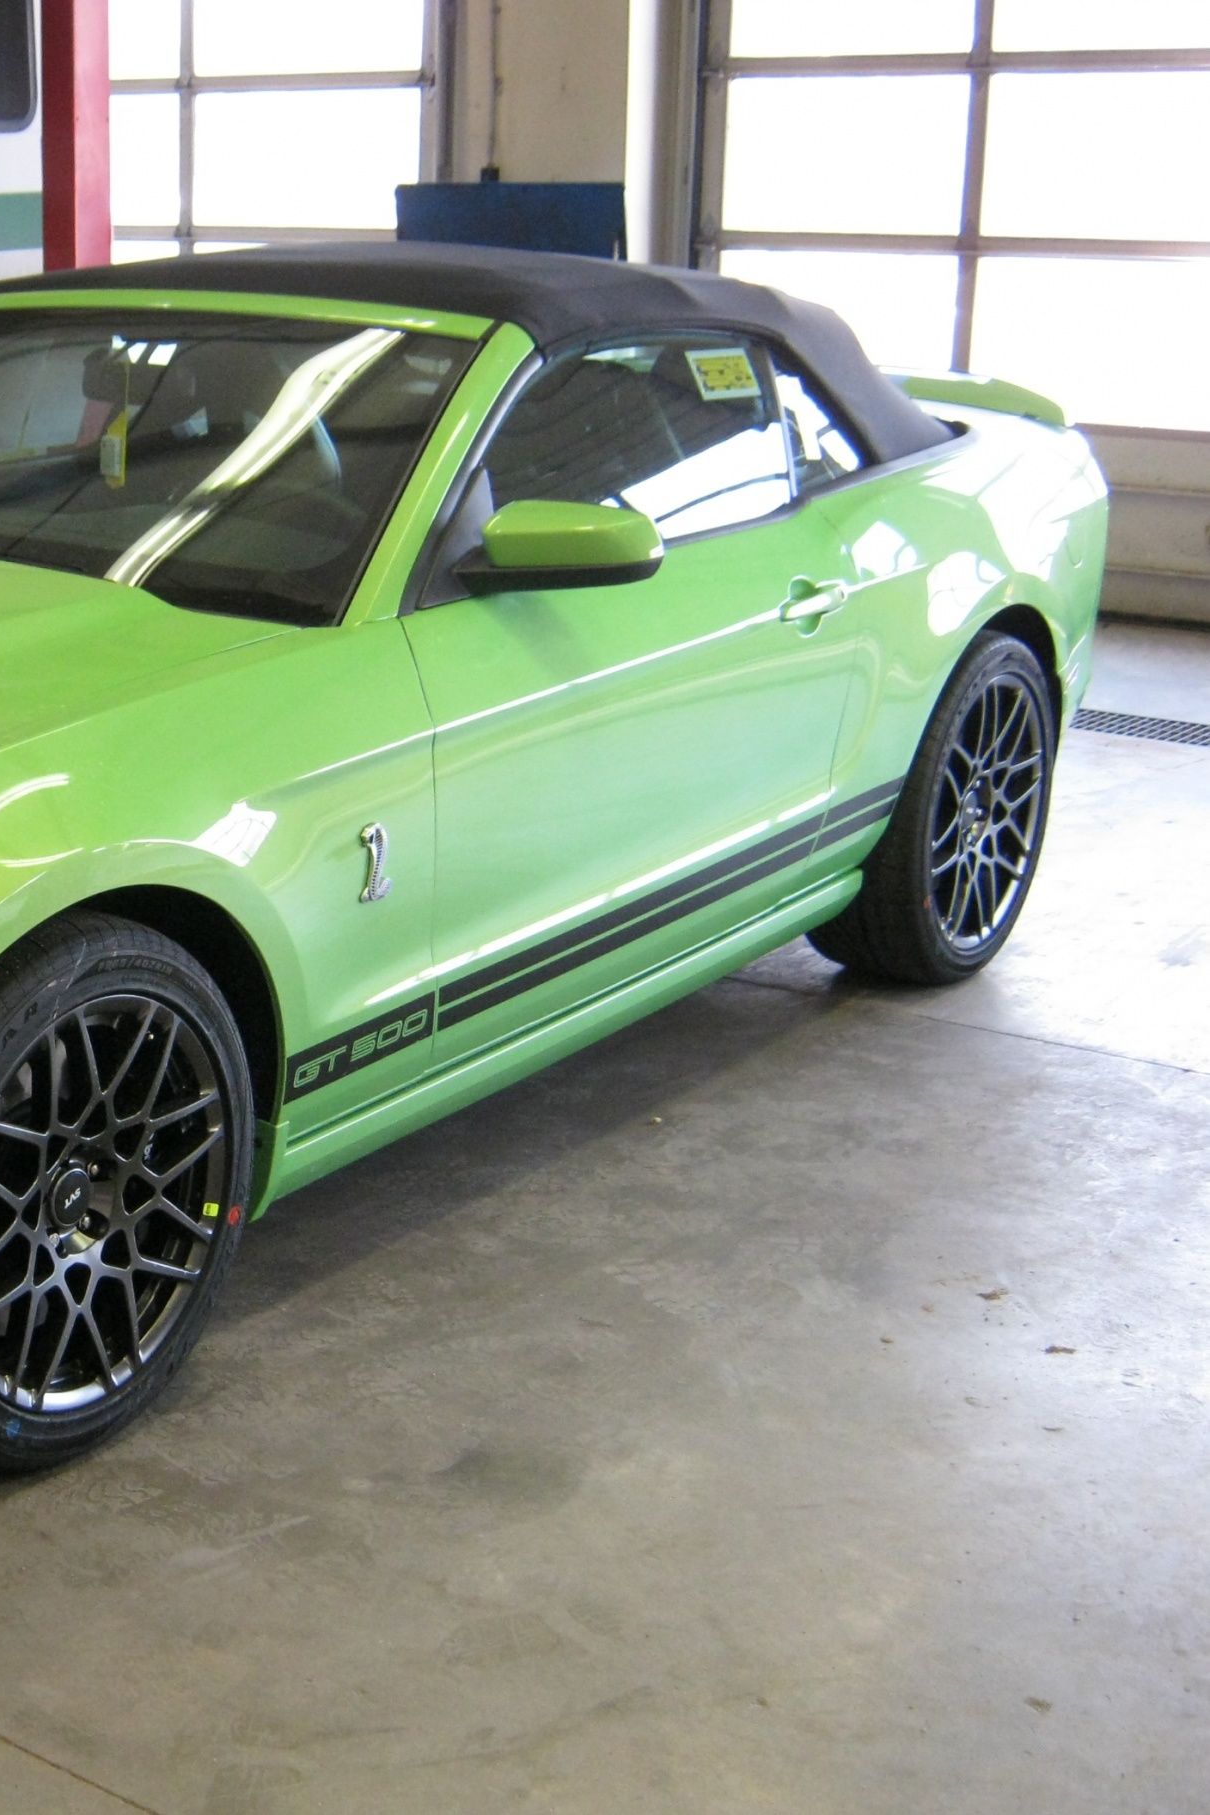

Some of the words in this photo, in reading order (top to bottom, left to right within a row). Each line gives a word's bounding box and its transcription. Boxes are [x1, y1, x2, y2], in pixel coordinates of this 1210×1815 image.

[293, 1045, 348, 1089] GT
[350, 1008, 428, 1063] 500
[63, 1187, 81, 1210] SVT
